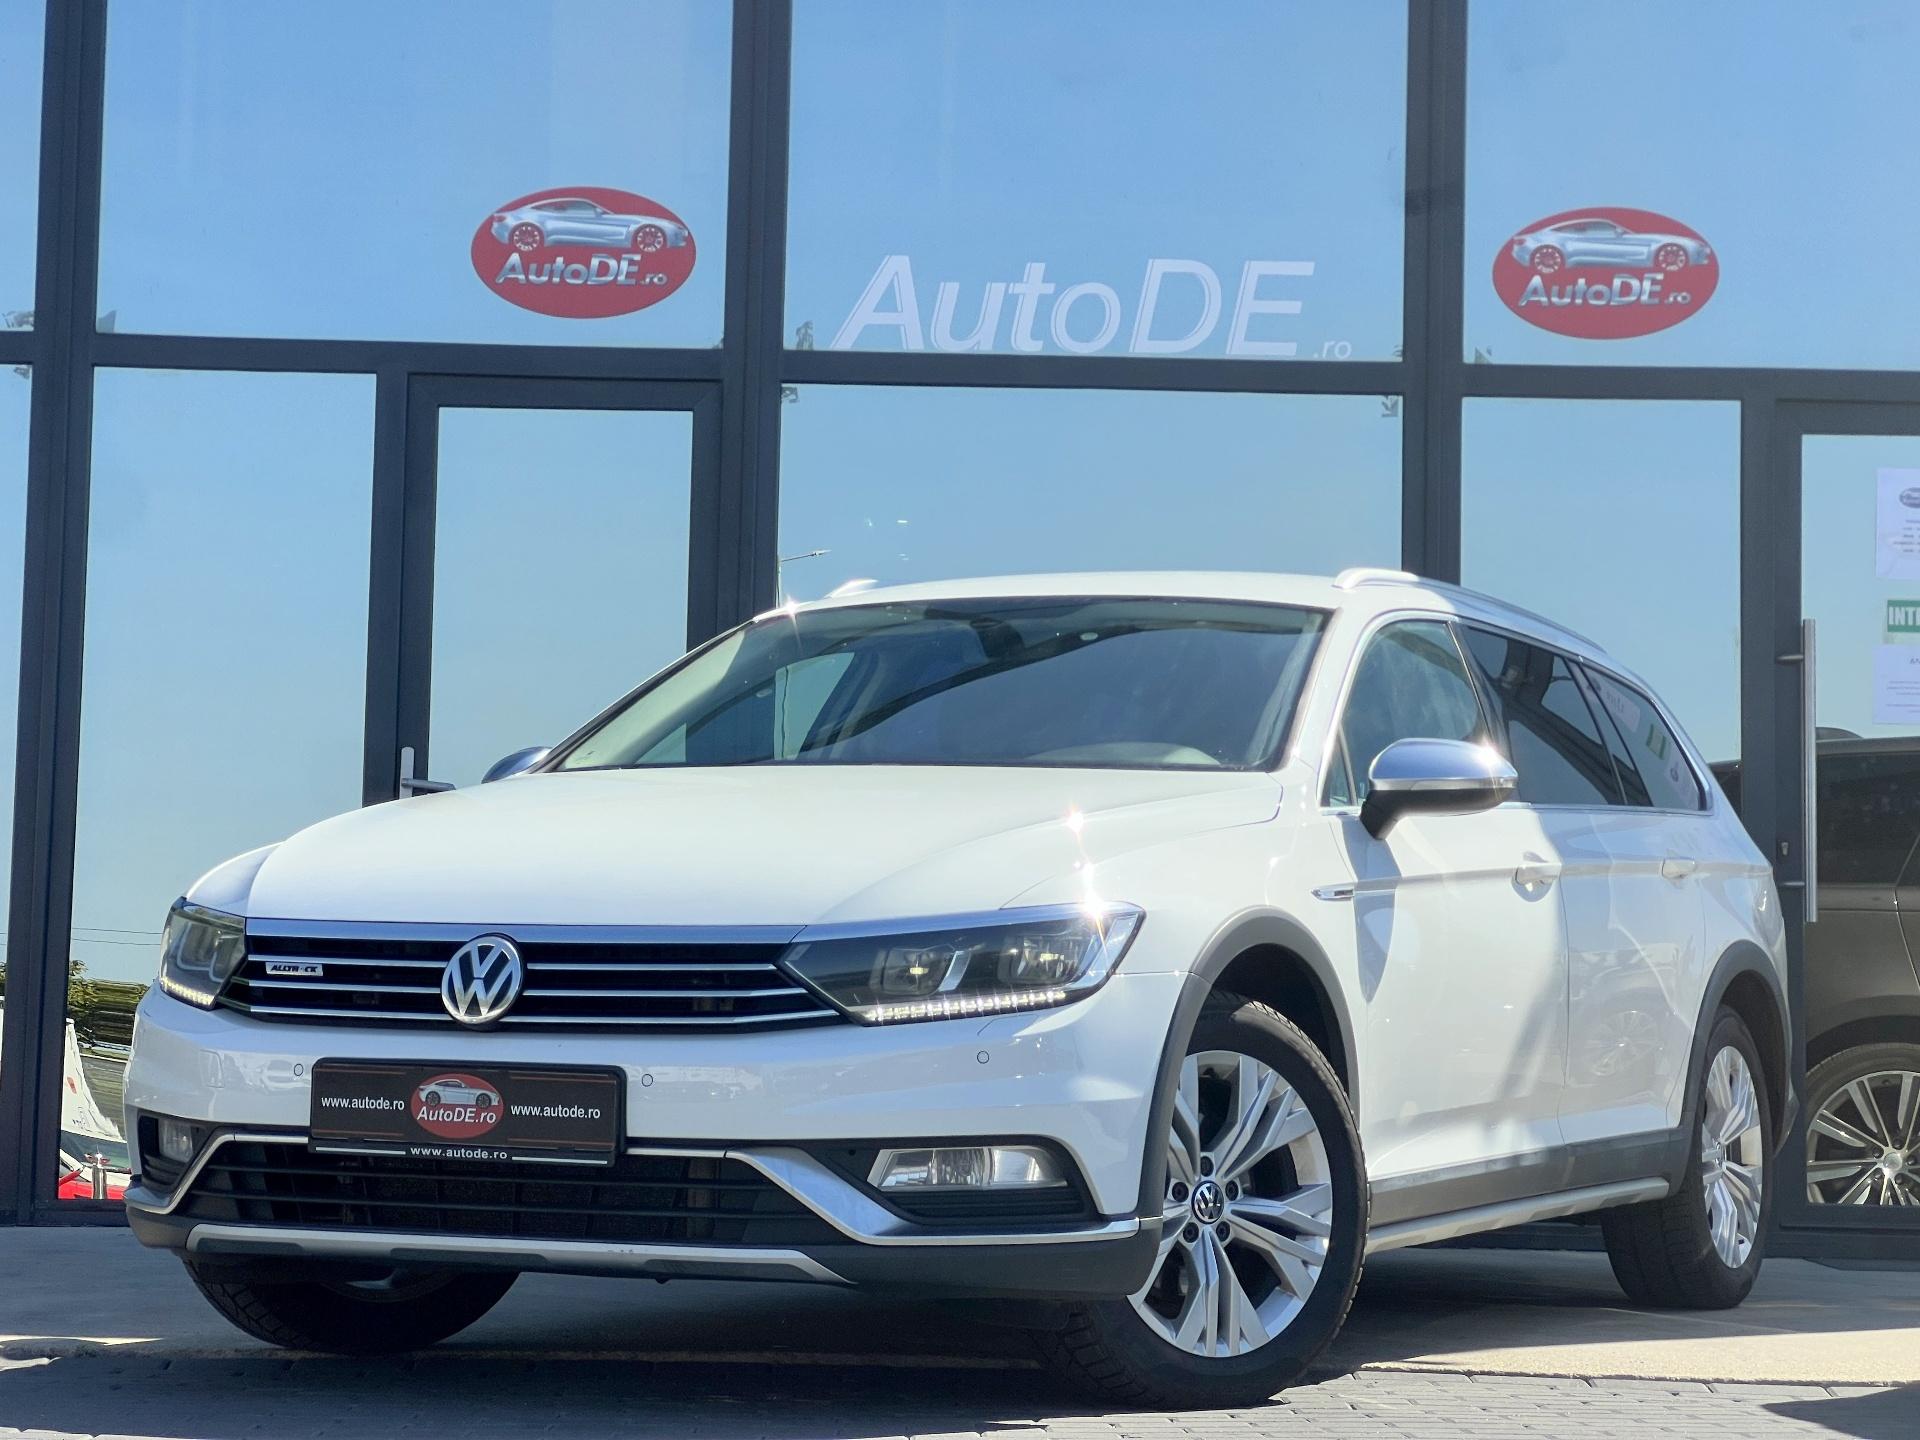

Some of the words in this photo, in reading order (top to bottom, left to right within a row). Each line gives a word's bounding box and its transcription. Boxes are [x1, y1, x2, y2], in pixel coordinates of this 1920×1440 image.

[320, 1094, 406, 1112] www.autode.ro
[510, 1102, 602, 1120] www.autode.ro
[416, 1105, 498, 1125] AutoDE.ro
[410, 1145, 508, 1161] www.autode.ro
